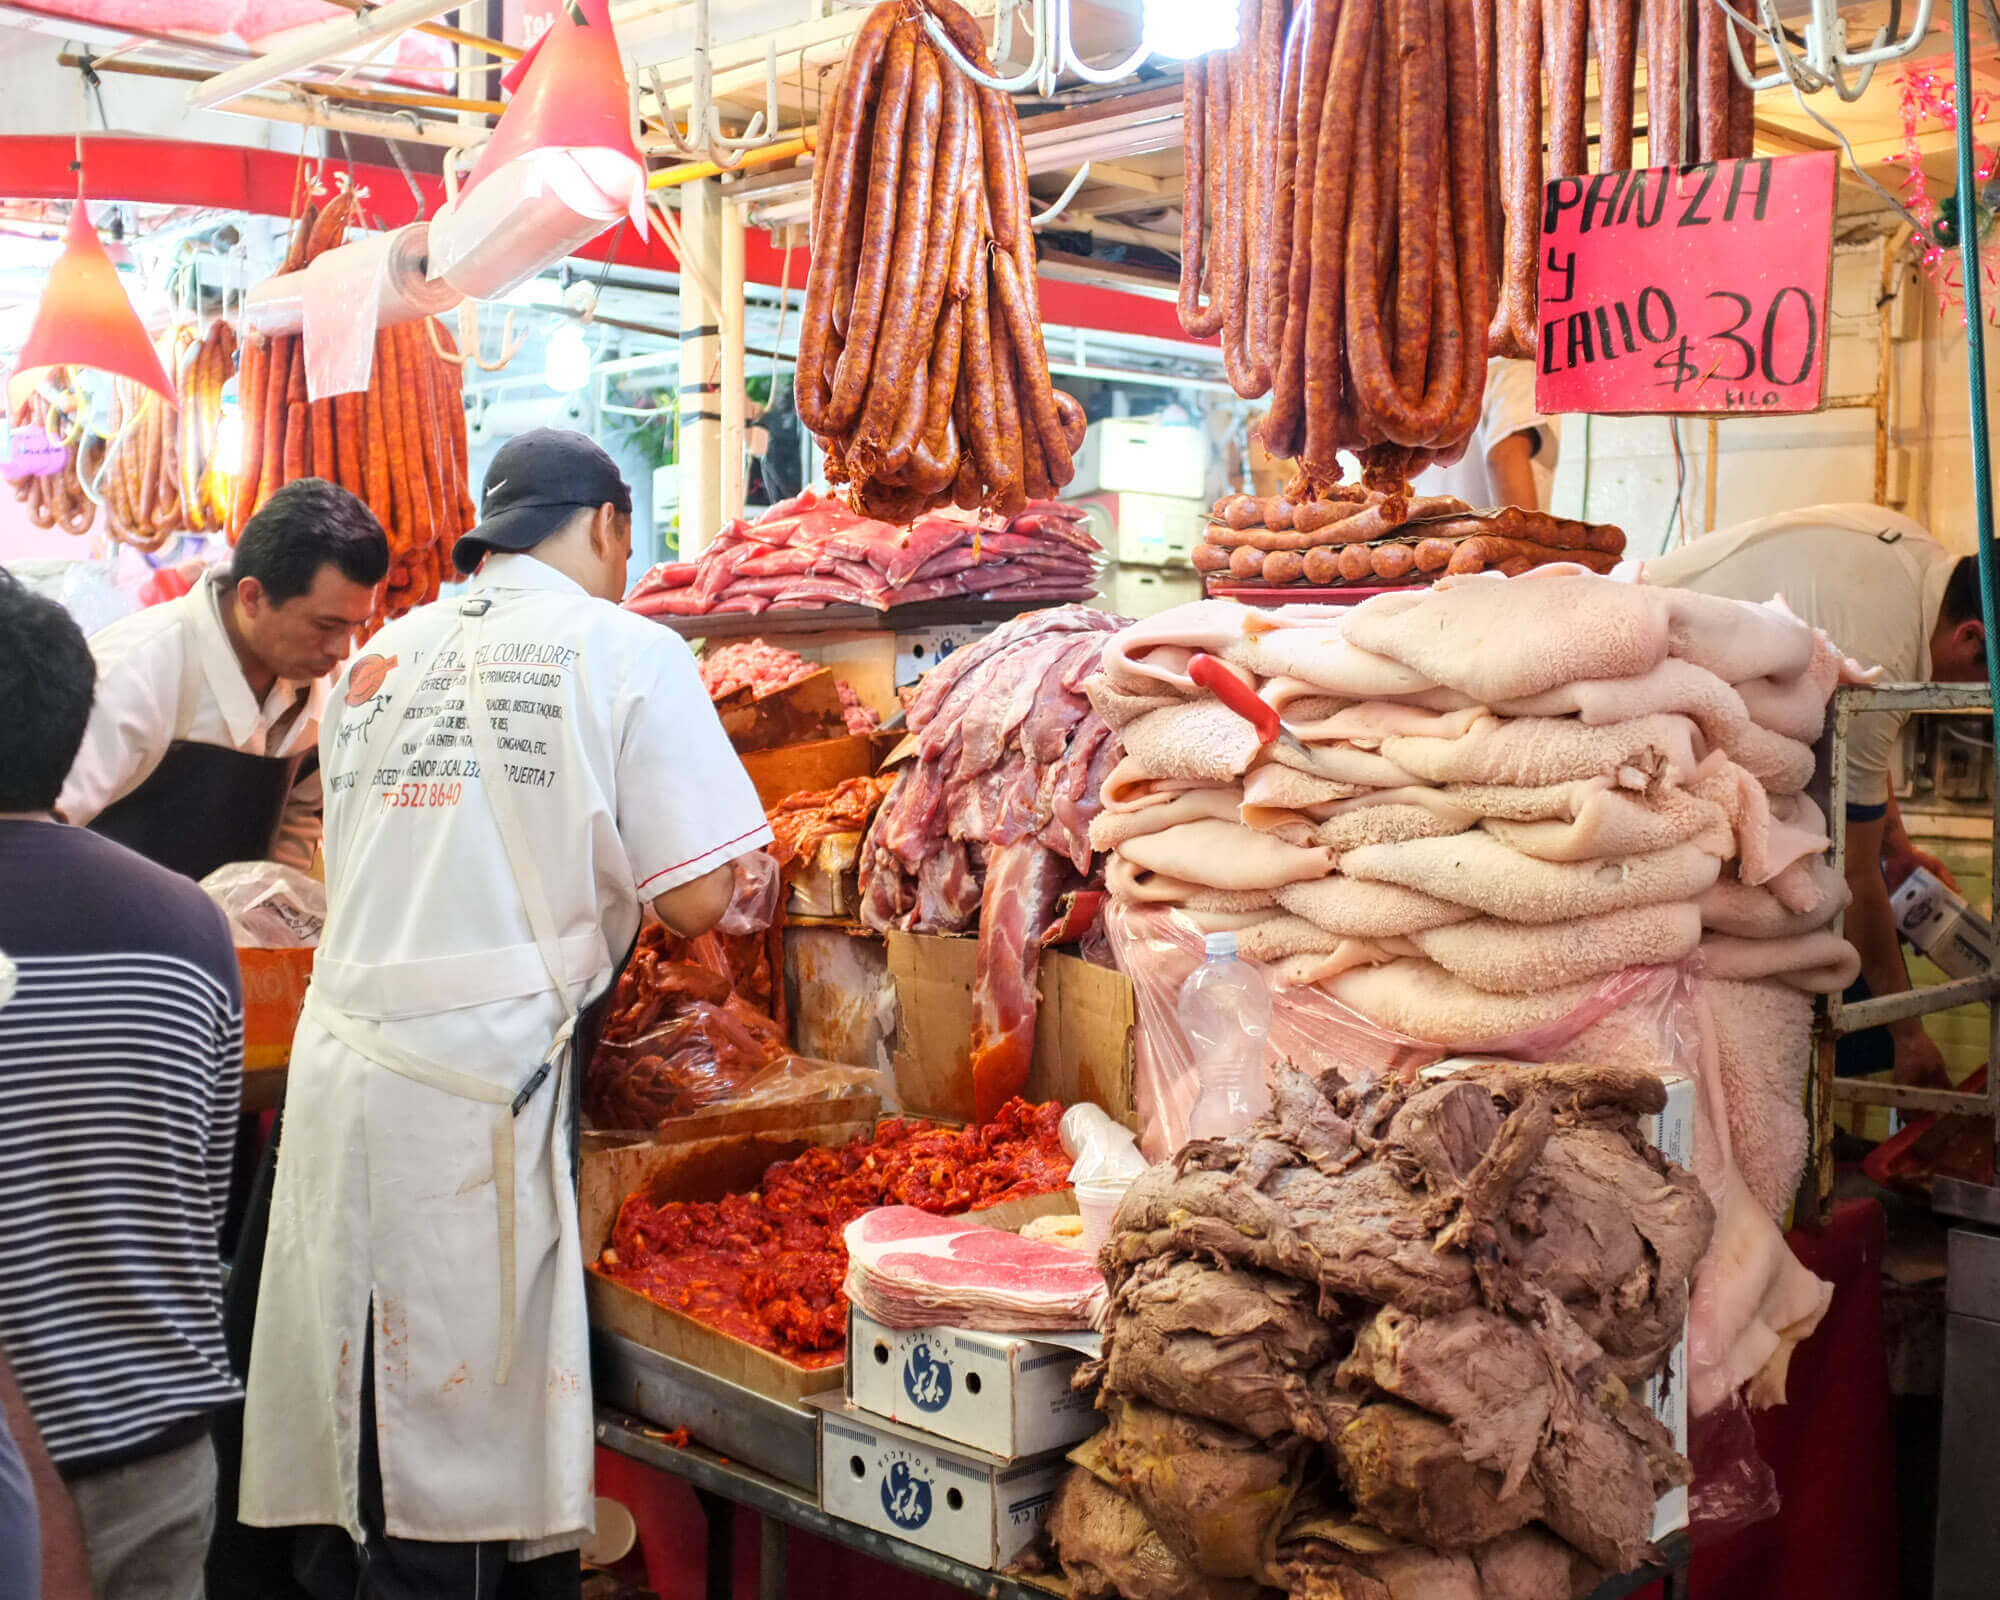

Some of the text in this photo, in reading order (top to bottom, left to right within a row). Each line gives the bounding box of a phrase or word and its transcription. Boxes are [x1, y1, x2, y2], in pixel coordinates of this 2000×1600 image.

[1543, 157, 1773, 235] PANZA
[1542, 285, 1678, 376] CALLO
[486, 670, 521, 684] PRIMERA
[523, 671, 562, 688] CALIDAD
[436, 758, 462, 777] LOCAL
[508, 764, 546, 787] PUERTA
[546, 769, 556, 789] 7
[428, 781, 463, 808] 8640
